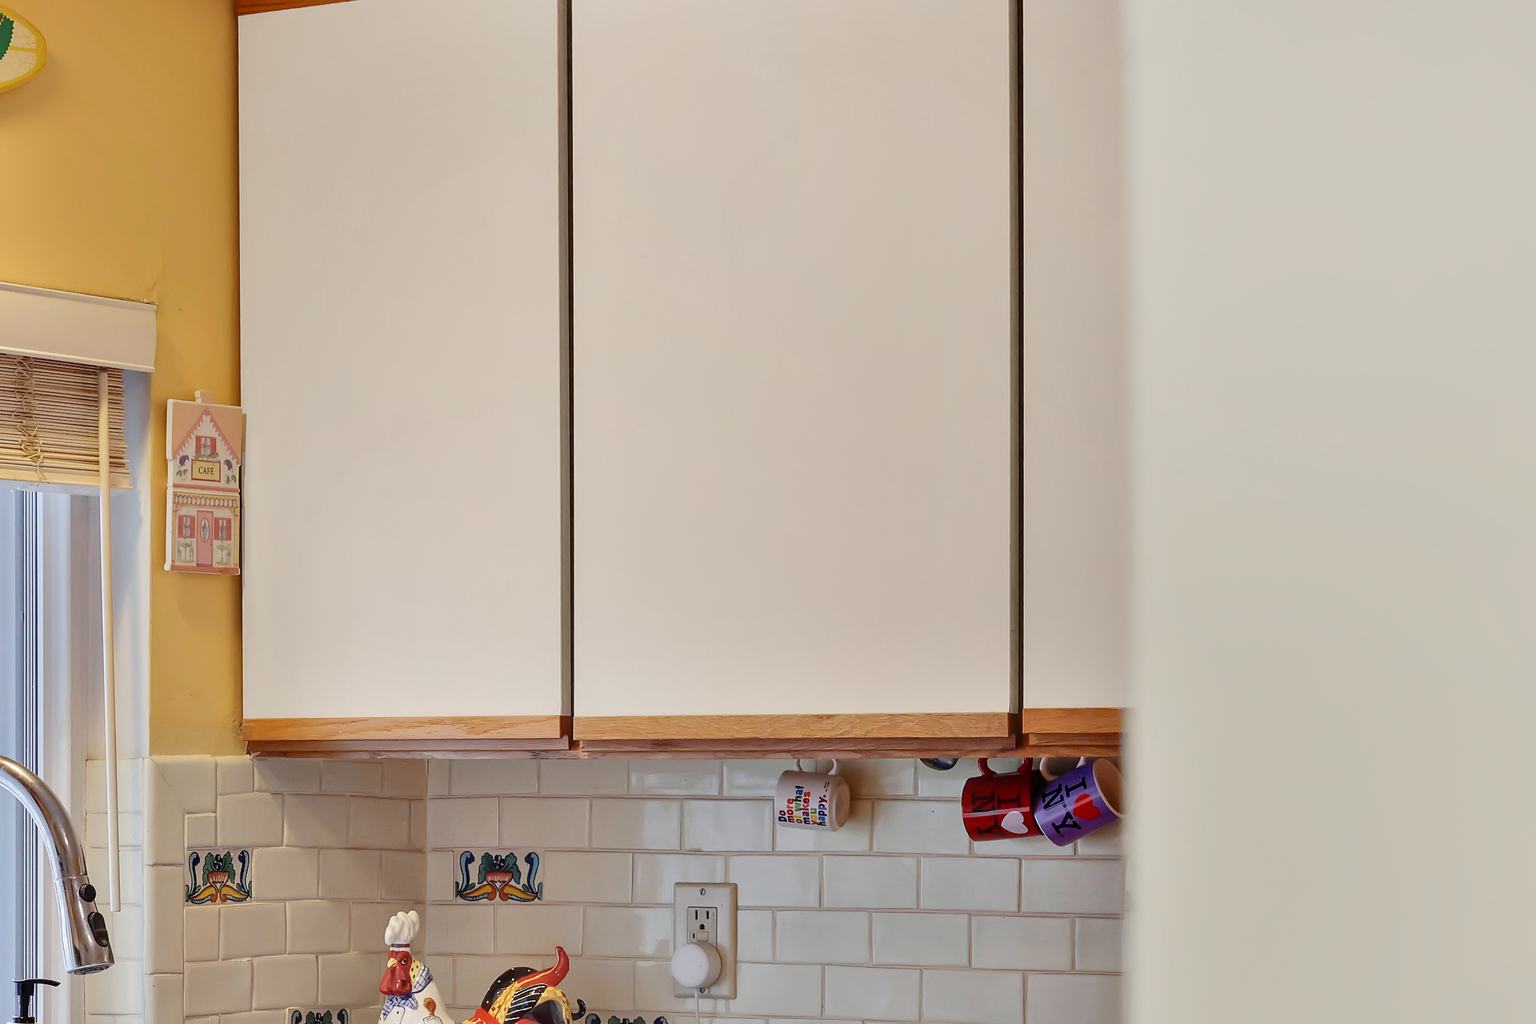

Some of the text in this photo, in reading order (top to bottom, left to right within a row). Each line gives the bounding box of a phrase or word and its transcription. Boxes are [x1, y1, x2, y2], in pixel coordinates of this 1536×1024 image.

[198, 466, 214, 475] CAFE
[793, 785, 804, 811] what
[800, 791, 811, 824] makes
[778, 810, 787, 822] Do
[786, 798, 795, 823] more
[810, 808, 820, 825] you
